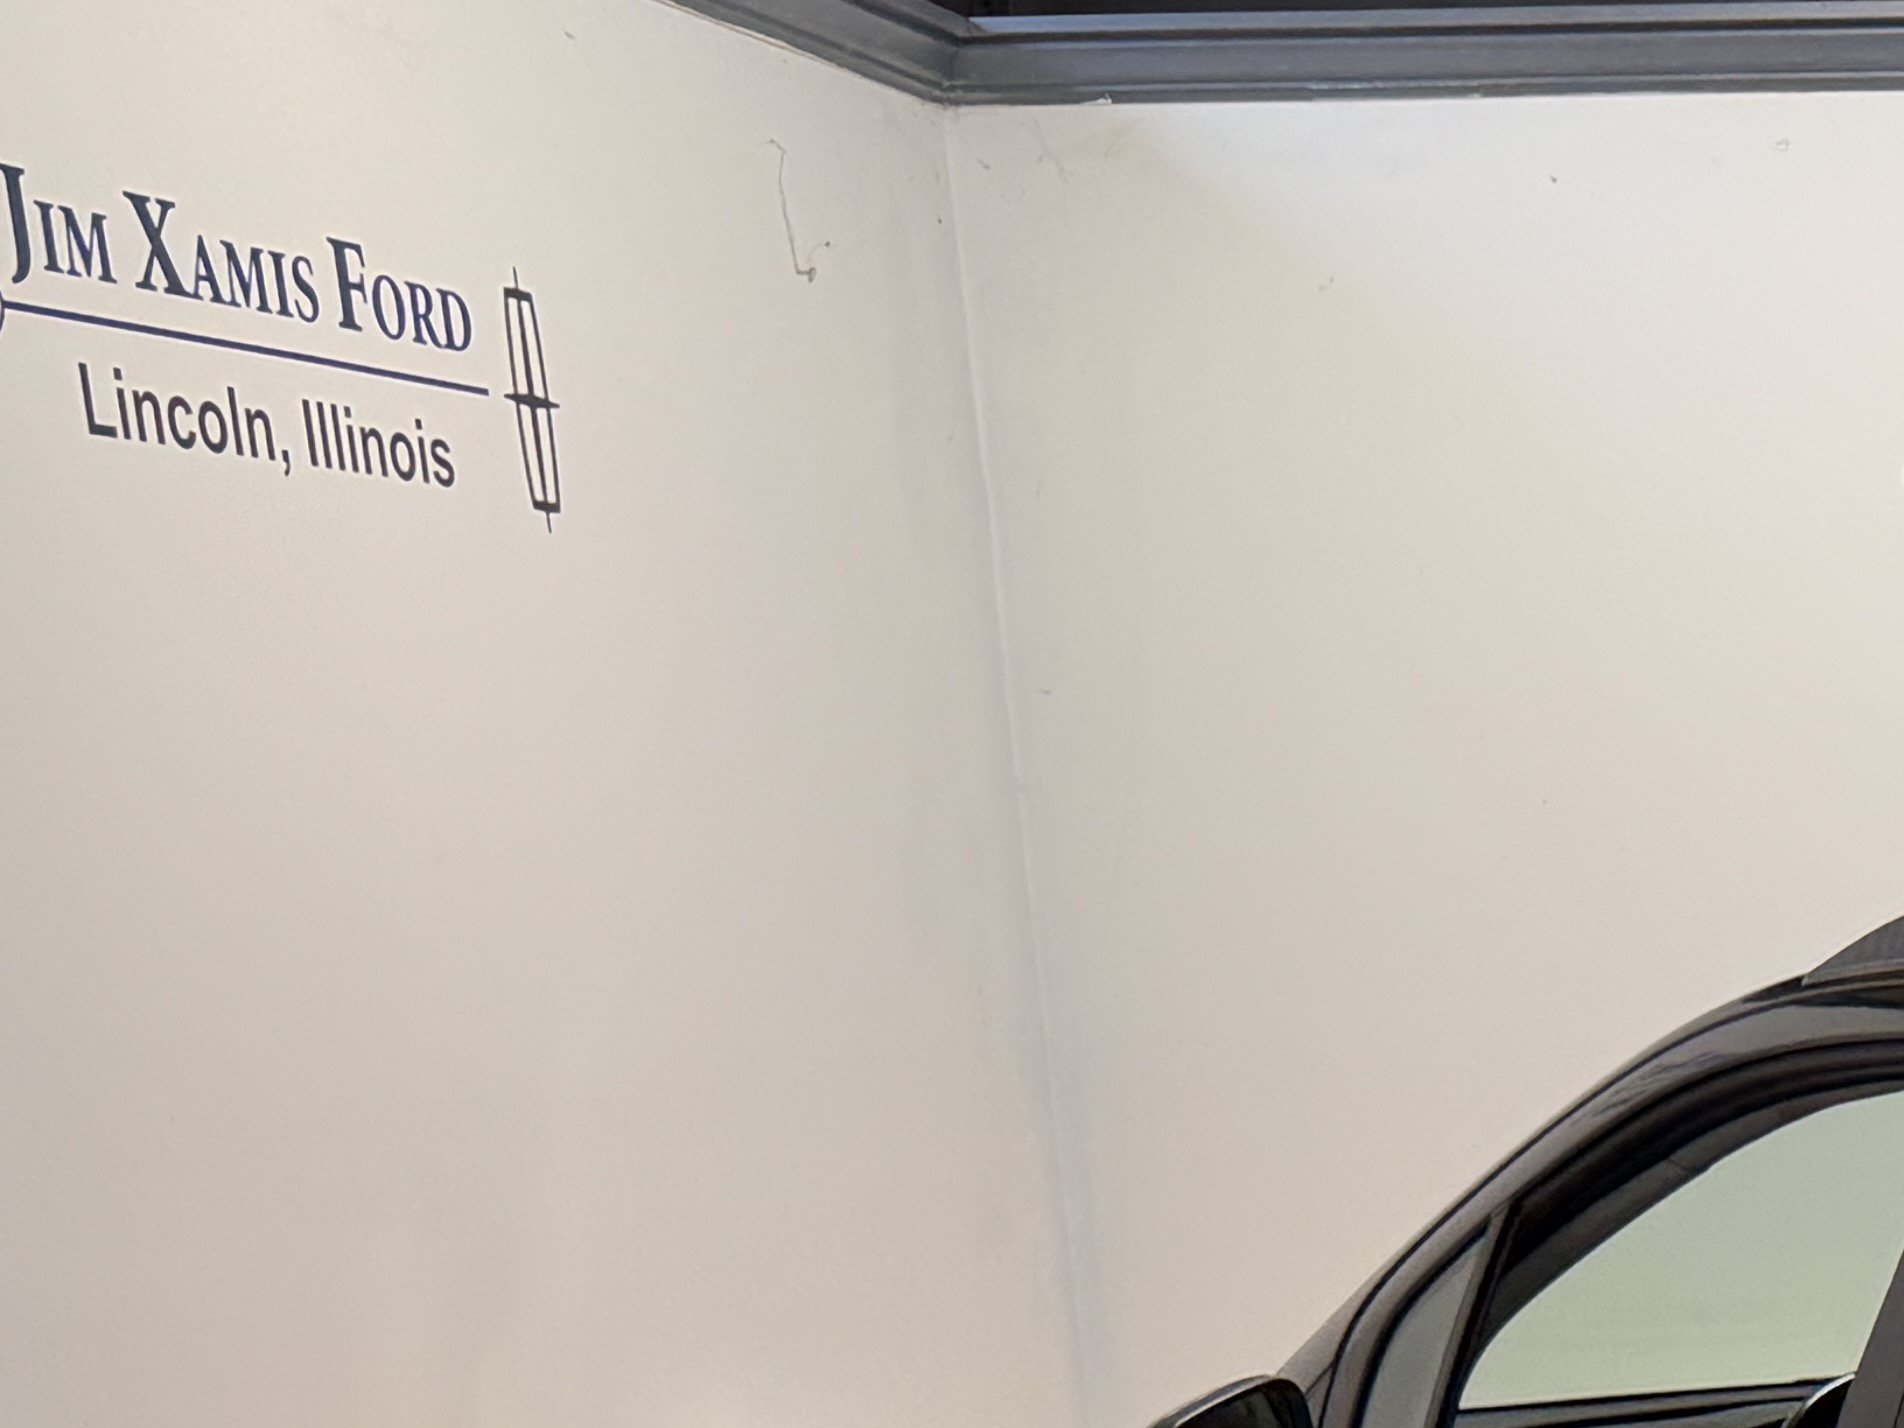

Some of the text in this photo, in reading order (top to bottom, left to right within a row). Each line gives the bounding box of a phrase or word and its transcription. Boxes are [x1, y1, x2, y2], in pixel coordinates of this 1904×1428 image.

[0, 162, 473, 352] JIM XAMIS FORD
[77, 361, 456, 488] Lincoln, Illinois
